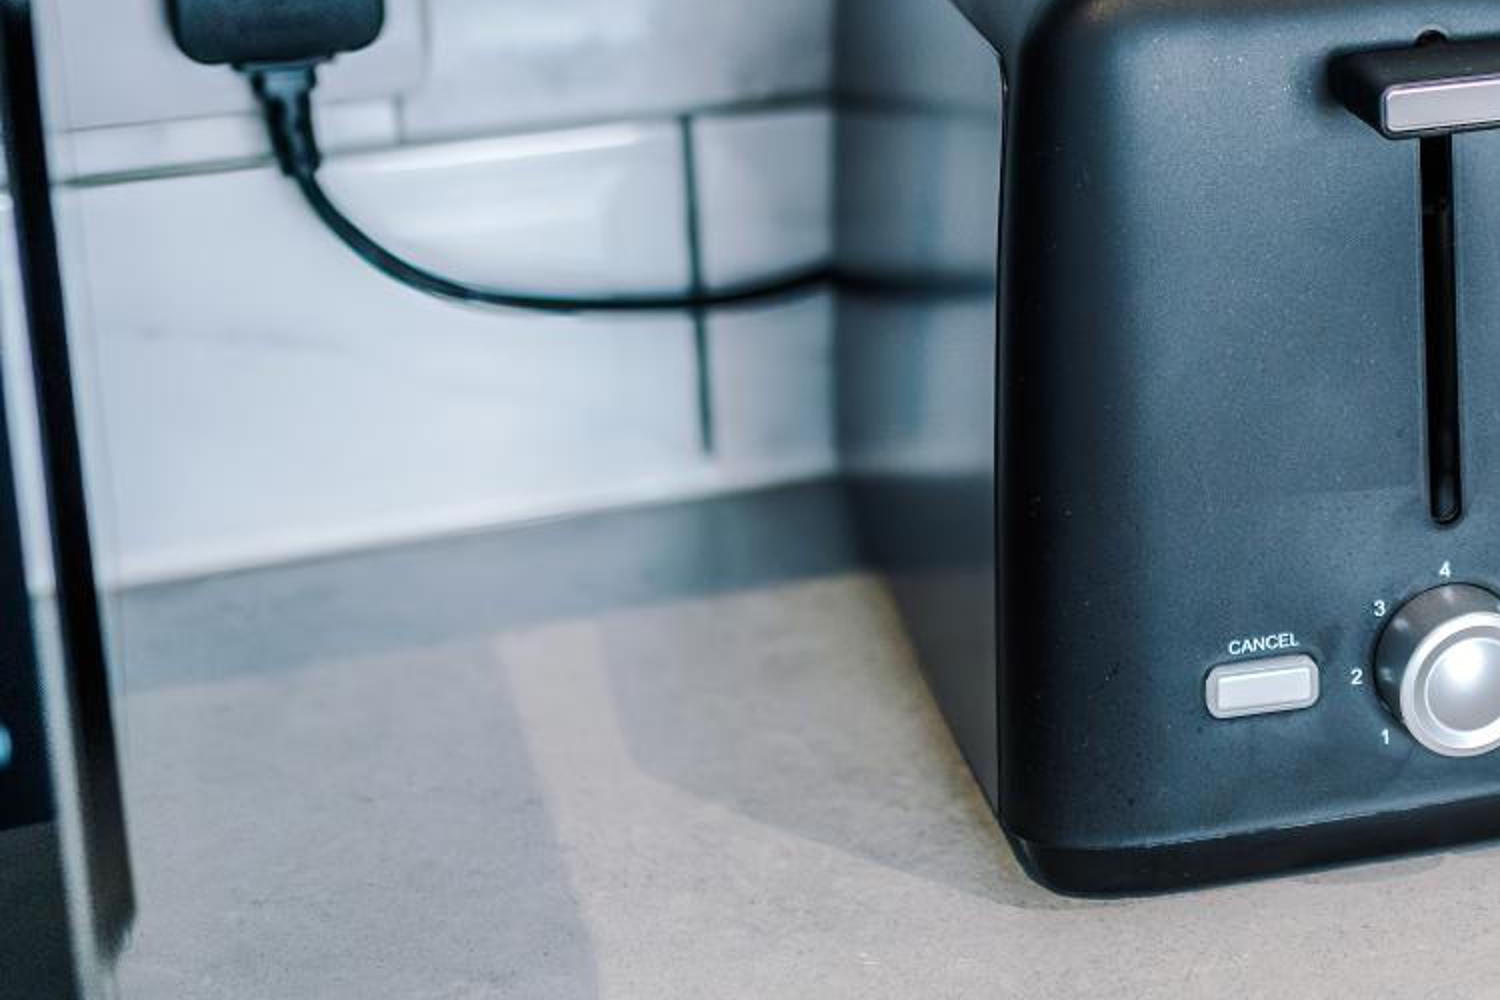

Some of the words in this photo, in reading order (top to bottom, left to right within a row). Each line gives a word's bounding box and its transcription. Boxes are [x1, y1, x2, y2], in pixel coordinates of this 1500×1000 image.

[1439, 560, 1451, 578] 4
[1373, 600, 1386, 617] 3
[1228, 632, 1299, 655] CANCEL
[1350, 667, 1363, 685] 2
[1381, 728, 1390, 745] 1
